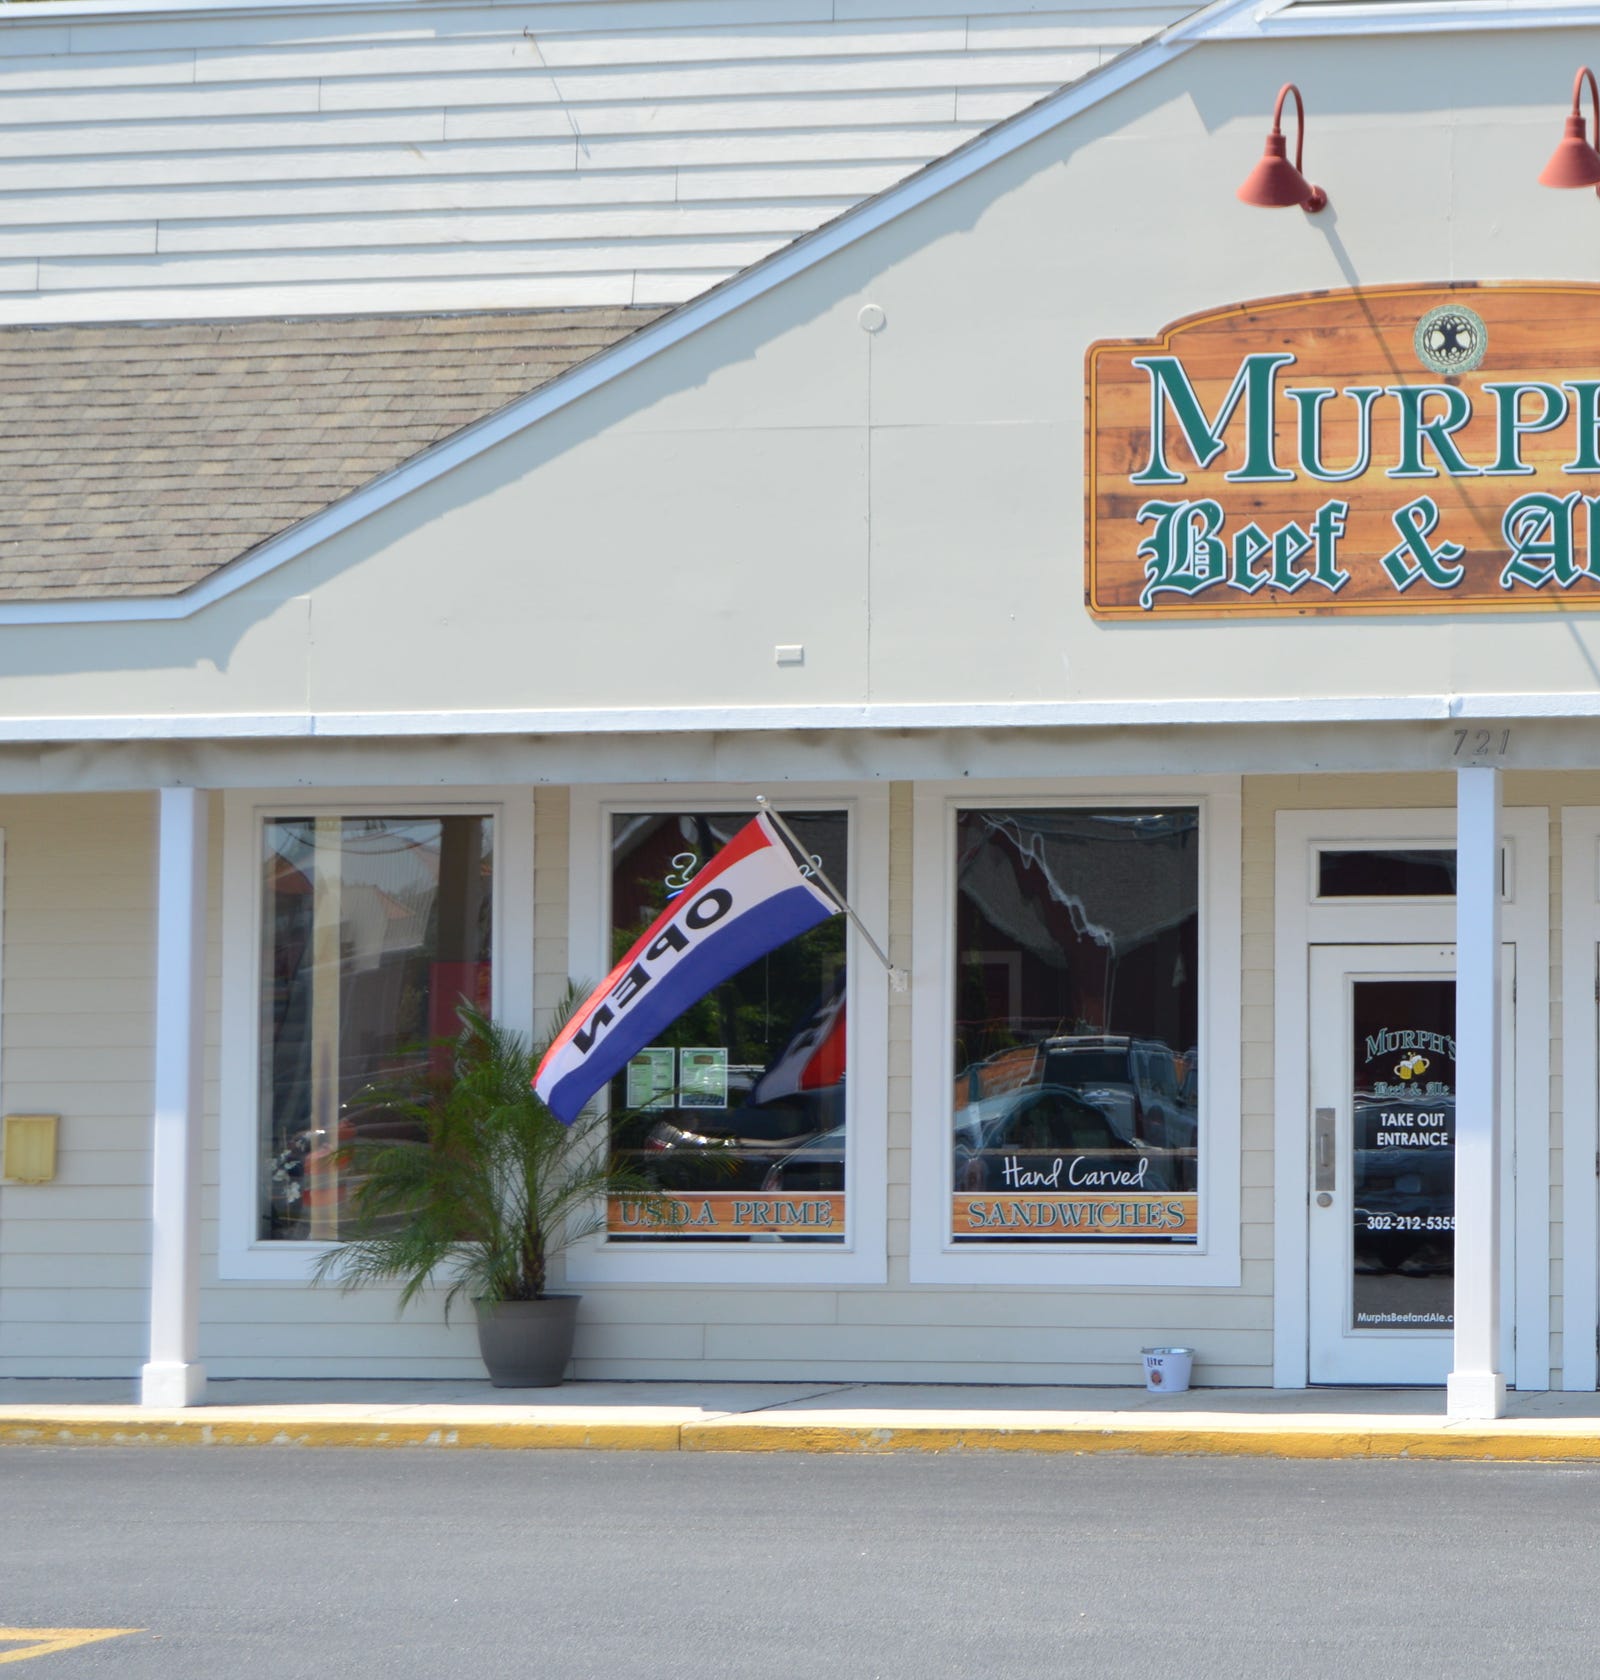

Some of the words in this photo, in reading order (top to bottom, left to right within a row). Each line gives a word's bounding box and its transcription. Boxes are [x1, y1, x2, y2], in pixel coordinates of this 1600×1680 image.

[1136, 499, 1350, 609] Beef
[1380, 495, 1466, 590] &
[1453, 729, 1510, 756] 721
[1380, 1113, 1414, 1126] TAKE
[1417, 1113, 1445, 1126] OUT
[1377, 1132, 1448, 1145] ENTRANCE
[1001, 1155, 1063, 1188] Hand
[1068, 1156, 1149, 1188] Carved
[732, 1200, 833, 1228] PRIME
[967, 1201, 1185, 1229] SANDWICHES
[1367, 1216, 1456, 1230] 302-212-5355
[1357, 1313, 1455, 1324] MurphsBeefandAle.c
